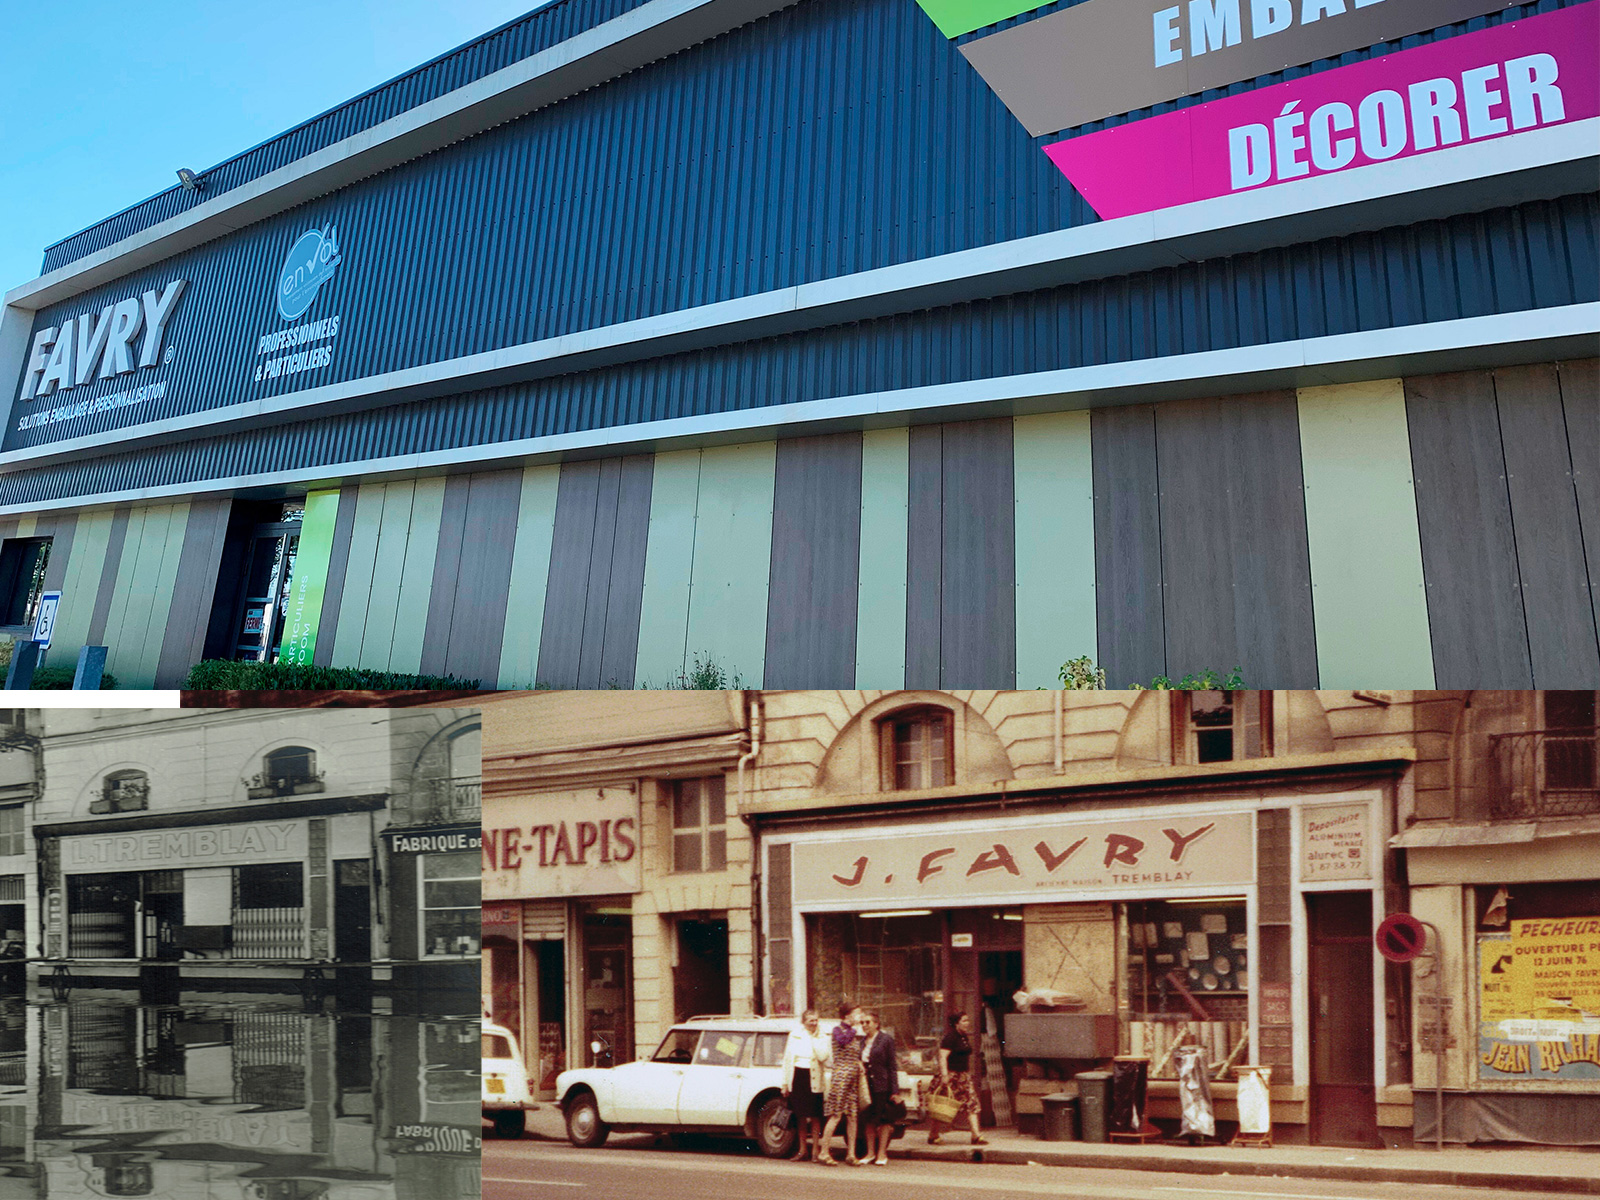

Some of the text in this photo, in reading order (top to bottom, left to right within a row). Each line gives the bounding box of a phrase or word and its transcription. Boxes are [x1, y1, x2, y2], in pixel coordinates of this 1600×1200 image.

[1153, 0, 1387, 68] EMB
[1228, 52, 1566, 190] DÉCORER
[19, 279, 187, 401] FAVRY
[258, 315, 340, 355] PROFESSIONNELS
[254, 345, 333, 382] & PARTICULIERS
[18, 410, 50, 431] SOLUTIONS
[288, 575, 308, 665] ARTICULIERS
[392, 834, 467, 853] FABRIQUE
[916, 822, 1215, 884] FAVRY
[1112, 870, 1193, 884] TREMBLAY
[1520, 921, 1600, 938] PECHEUR
[1515, 944, 1585, 955] OUVERTURE
[1534, 956, 1587, 966] 12 JUIN 76
[1482, 1040, 1532, 1074] JEAN
